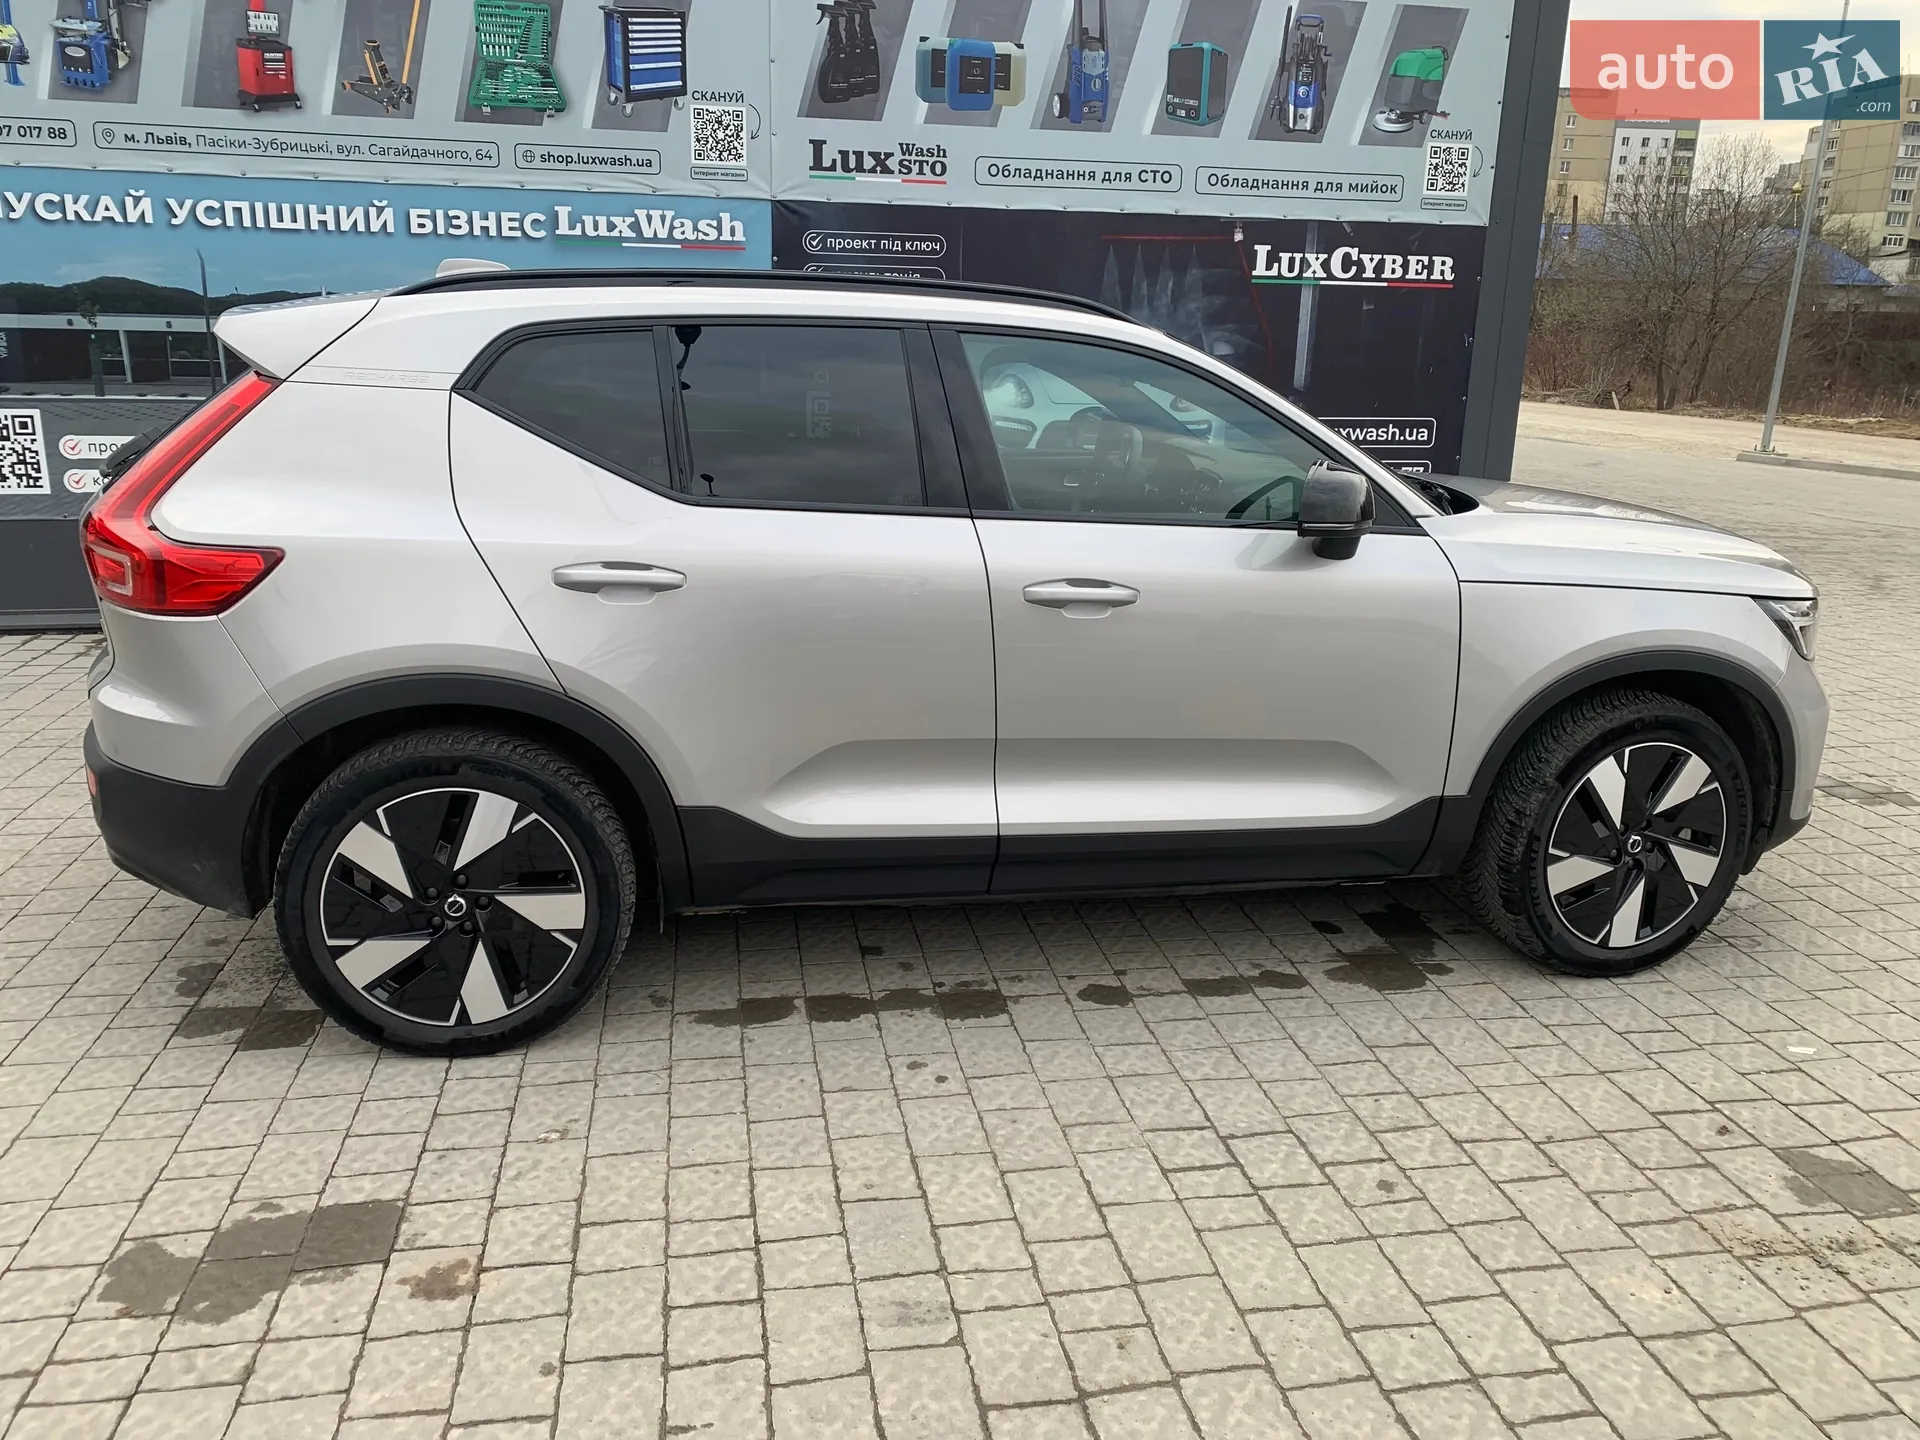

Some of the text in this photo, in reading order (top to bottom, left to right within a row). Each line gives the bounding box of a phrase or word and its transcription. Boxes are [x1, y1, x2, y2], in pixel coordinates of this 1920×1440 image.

[691, 90, 745, 103] СКАНУЙ
[17, 125, 42, 138] 017
[47, 126, 67, 140] 88
[1429, 129, 1473, 141] СКАНУЙ
[124, 132, 493, 163] м. Львів, Пасіки-Зубрицькі, вул. Сагайдачного, 64
[540, 151, 653, 169] shop.luxwash.ua
[808, 139, 947, 176] Lux Wash
[898, 159, 947, 177] STO
[987, 163, 1173, 184] Обладнання для СТО
[1207, 173, 1398, 195] Обладнання для мийок
[0, 189, 746, 242] УСКАЙ УСПІШНИЙ БІЗНЕС LuxWash
[827, 237, 940, 251] проект під ключ
[344, 371, 430, 384] RECHARGE
[1334, 423, 1429, 441] xwash.ua
